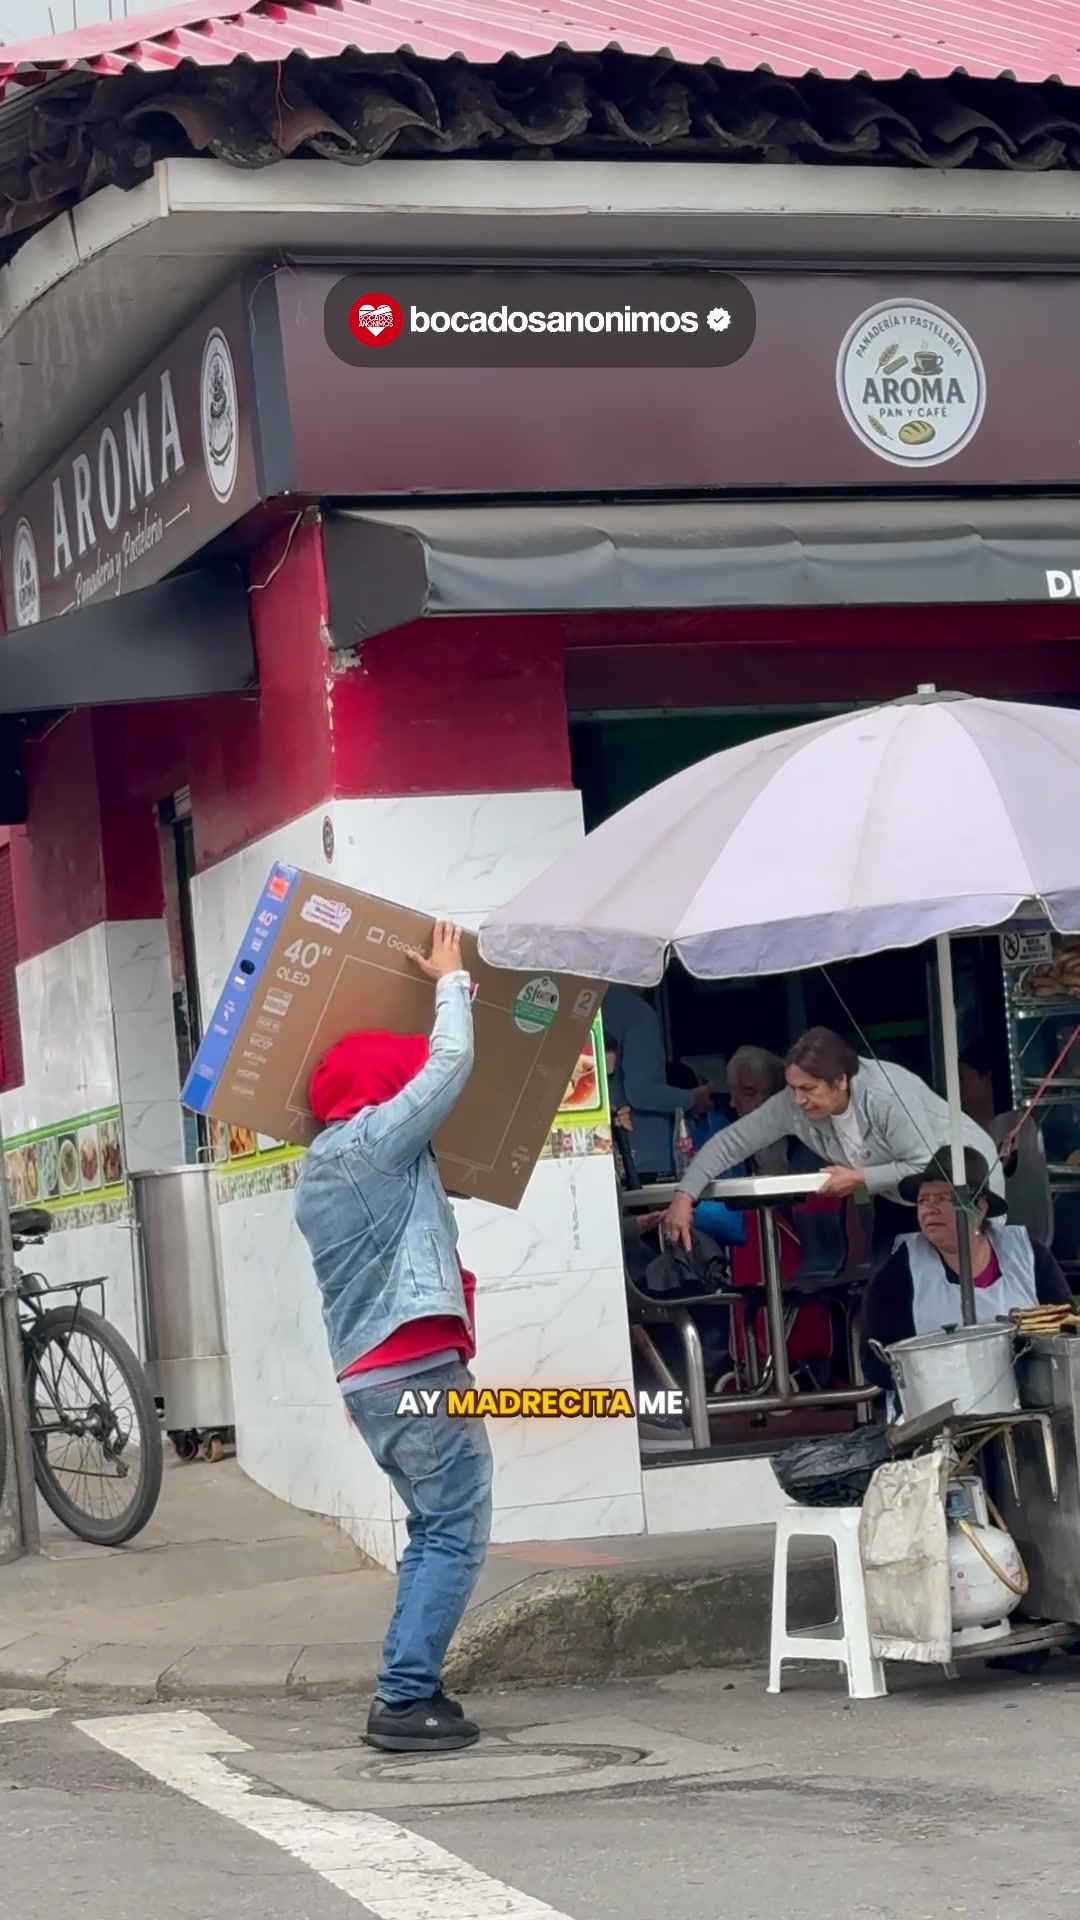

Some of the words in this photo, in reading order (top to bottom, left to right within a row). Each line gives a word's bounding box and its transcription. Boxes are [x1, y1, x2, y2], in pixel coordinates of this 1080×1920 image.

[856, 314, 901, 358] PANADERÍA
[901, 315, 908, 325] Y
[909, 315, 963, 357] PASTELERÍA
[862, 377, 966, 405] AROMA
[879, 407, 903, 418] PAN
[907, 408, 914, 417] Y
[917, 405, 948, 418] CAFÉ
[53, 369, 185, 577] AROMA
[283, 938, 333, 969] 40"
[276, 966, 311, 987] QLED
[578, 991, 592, 1010] 2
